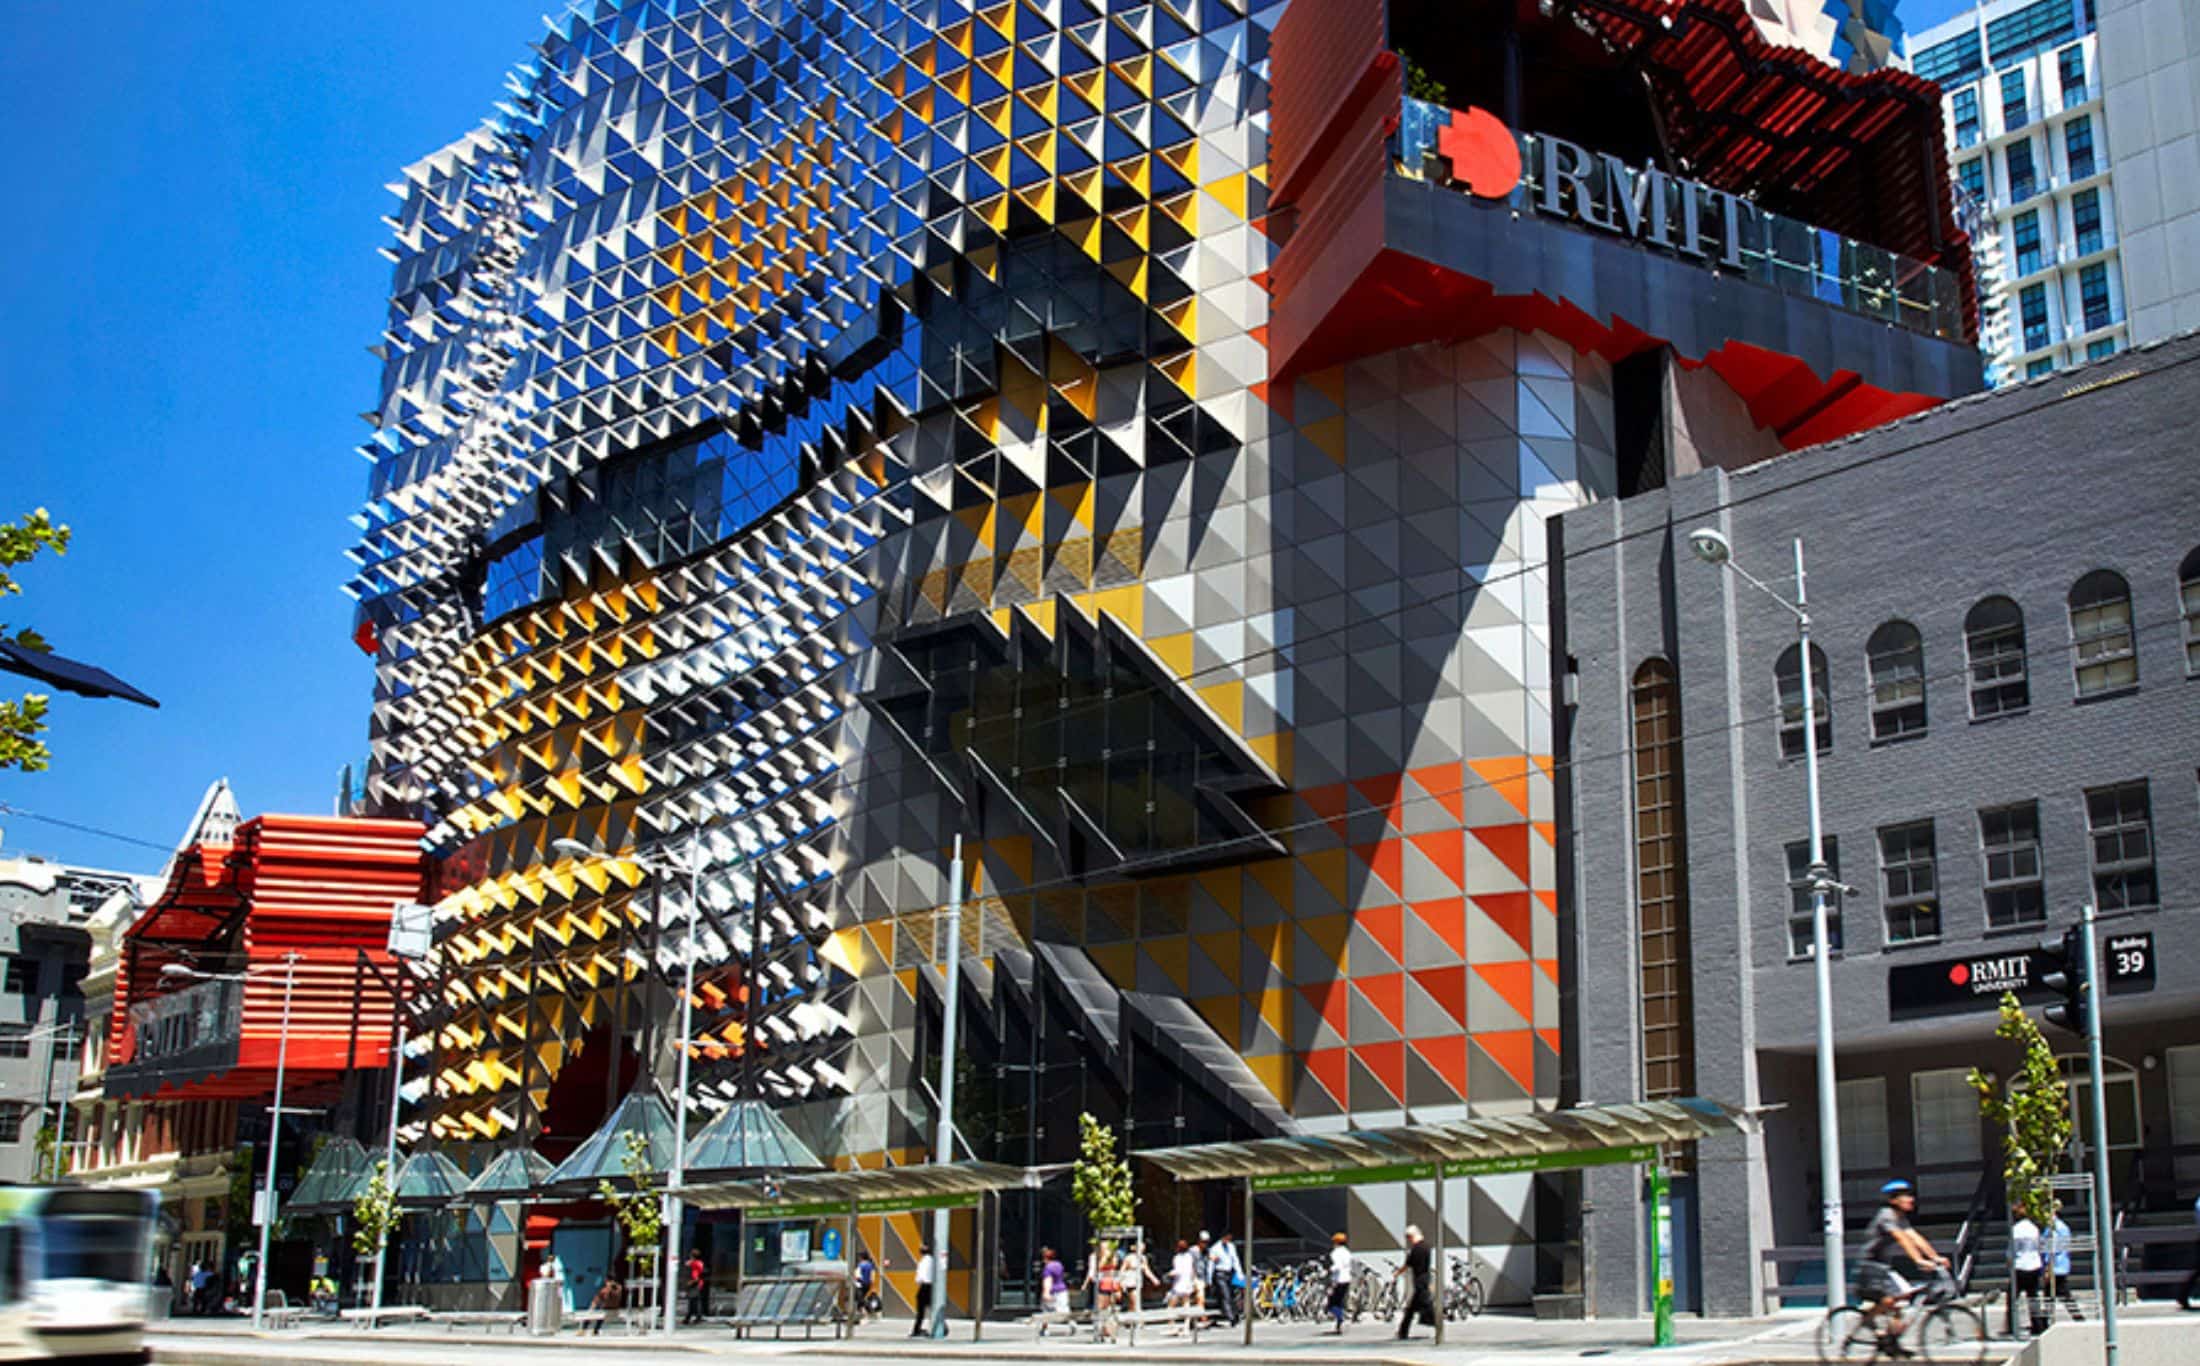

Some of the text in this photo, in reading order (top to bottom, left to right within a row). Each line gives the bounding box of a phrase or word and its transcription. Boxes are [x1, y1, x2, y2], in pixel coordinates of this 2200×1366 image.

[1534, 131, 1757, 269] RMIT
[1971, 955, 2032, 982] RMIT
[2116, 951, 2145, 976] 39
